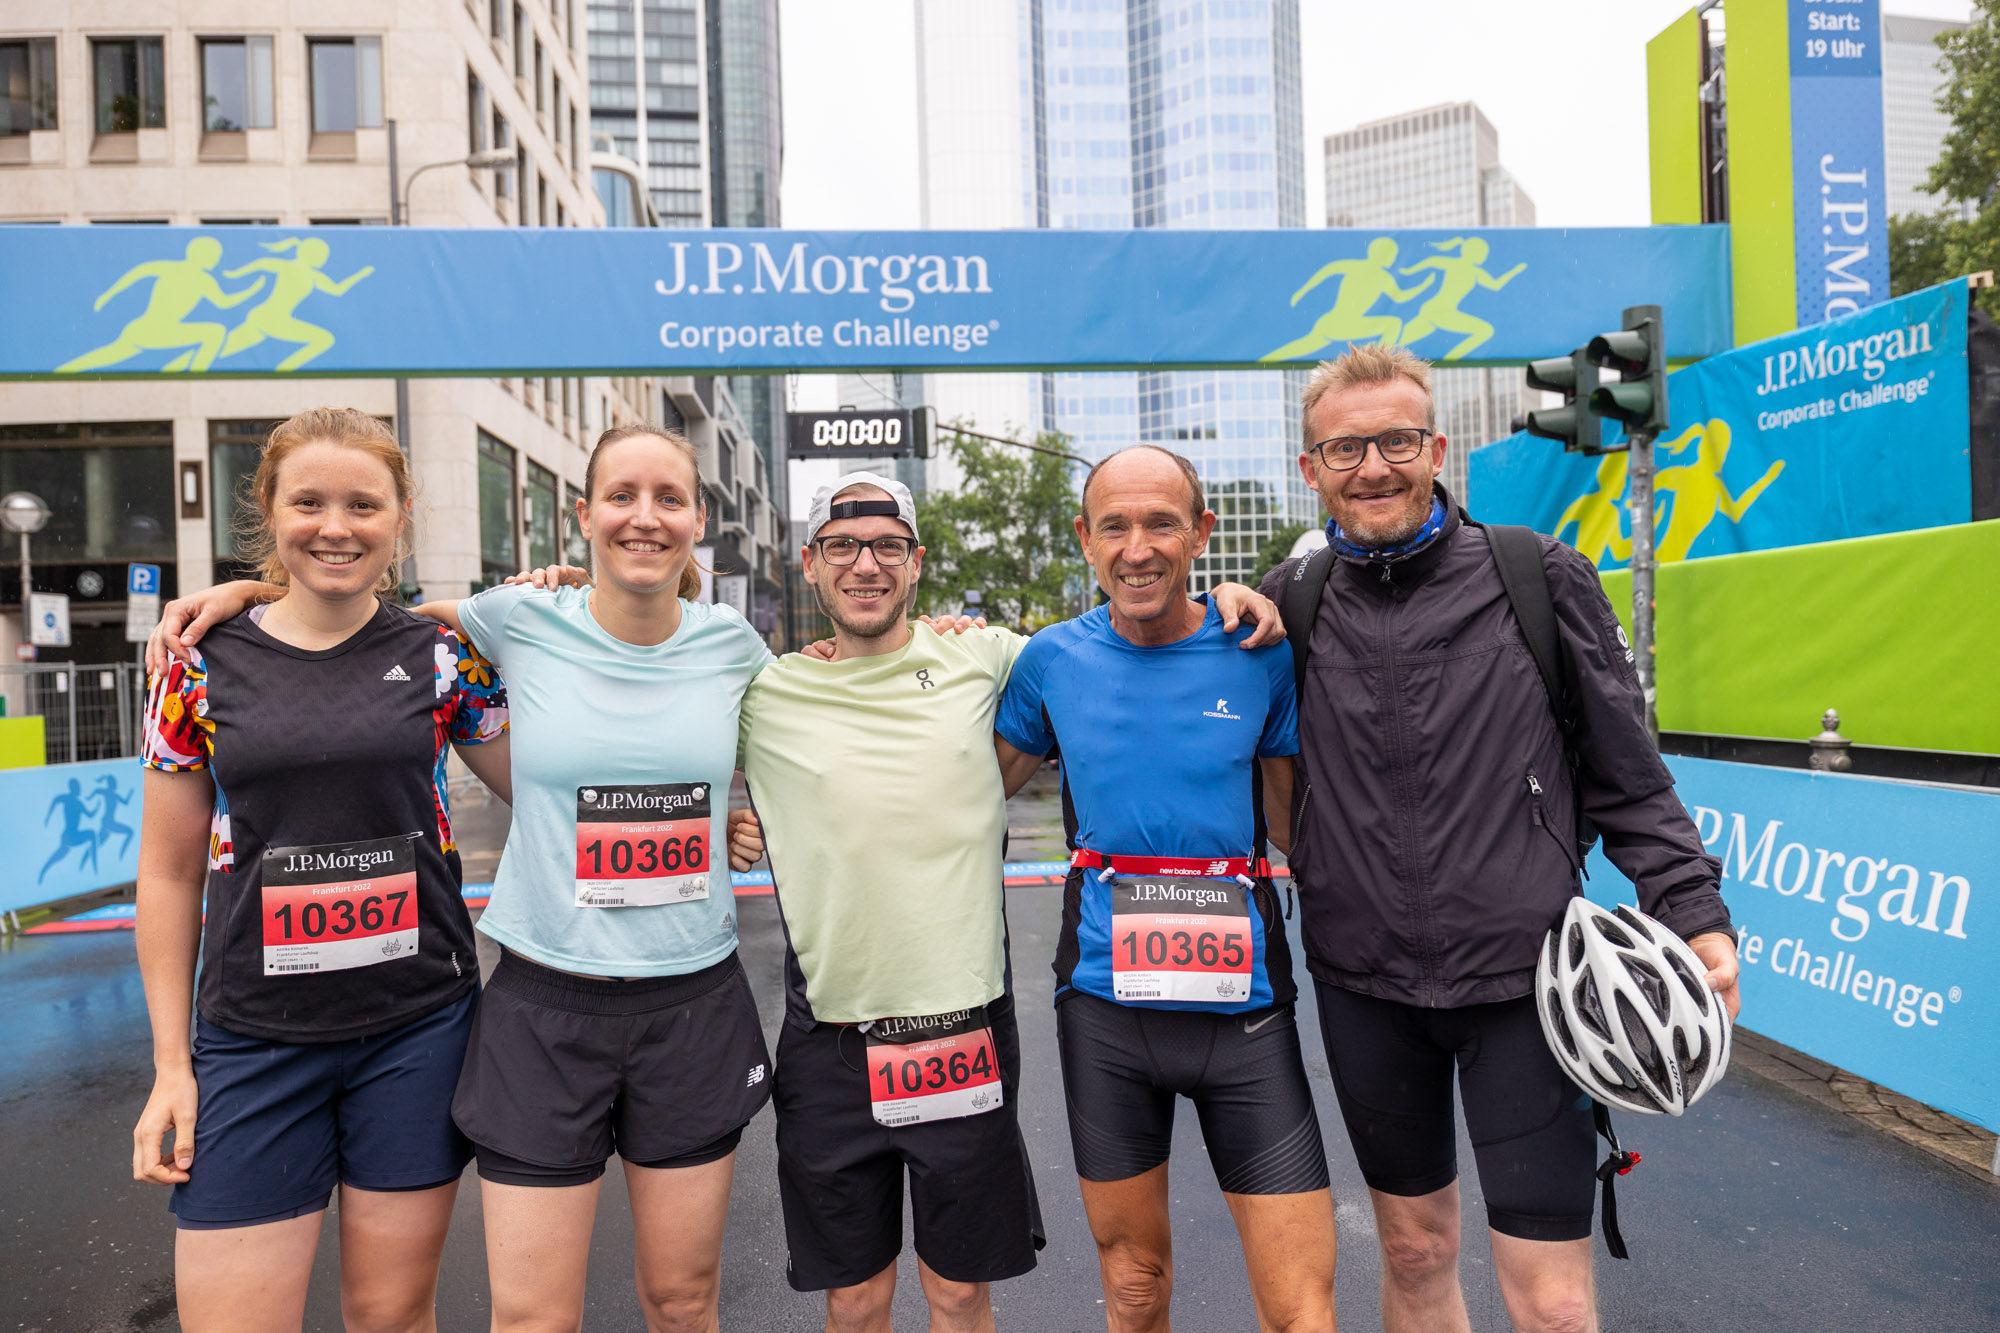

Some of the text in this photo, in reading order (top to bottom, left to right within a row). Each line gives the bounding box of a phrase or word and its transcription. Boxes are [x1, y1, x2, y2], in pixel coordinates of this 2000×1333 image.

[1808, 11, 1860, 31] Start:
[1806, 38, 1866, 58] 19 Uhr
[655, 242, 993, 313] J.P.Morgan
[659, 321, 823, 353] Corporate
[1756, 321, 1934, 396] J.P.Morgan
[1757, 398, 1836, 431] Corporate
[1203, 711, 1241, 720] KOSSMANN
[597, 792, 693, 813] J.P.Morgan
[621, 824, 673, 833] Frankfurt 2022
[284, 849, 394, 872] J.P.Morgan
[586, 835, 703, 874] 10366
[1159, 867, 1202, 876] new balance
[1692, 804, 1971, 942] PMorgan
[312, 883, 372, 896] Frankfurt 2022
[1131, 884, 1228, 907] J.P.Morgan
[274, 891, 409, 940] 10367
[1155, 917, 1189, 925] Frankfurt
[1122, 931, 1245, 968] 10365
[882, 1008, 971, 1036] J.P.Morgan
[908, 1039, 957, 1053] Frankfurt 2022
[878, 1046, 993, 1095] 10364
[1667, 1055, 1682, 1097] RUDY
